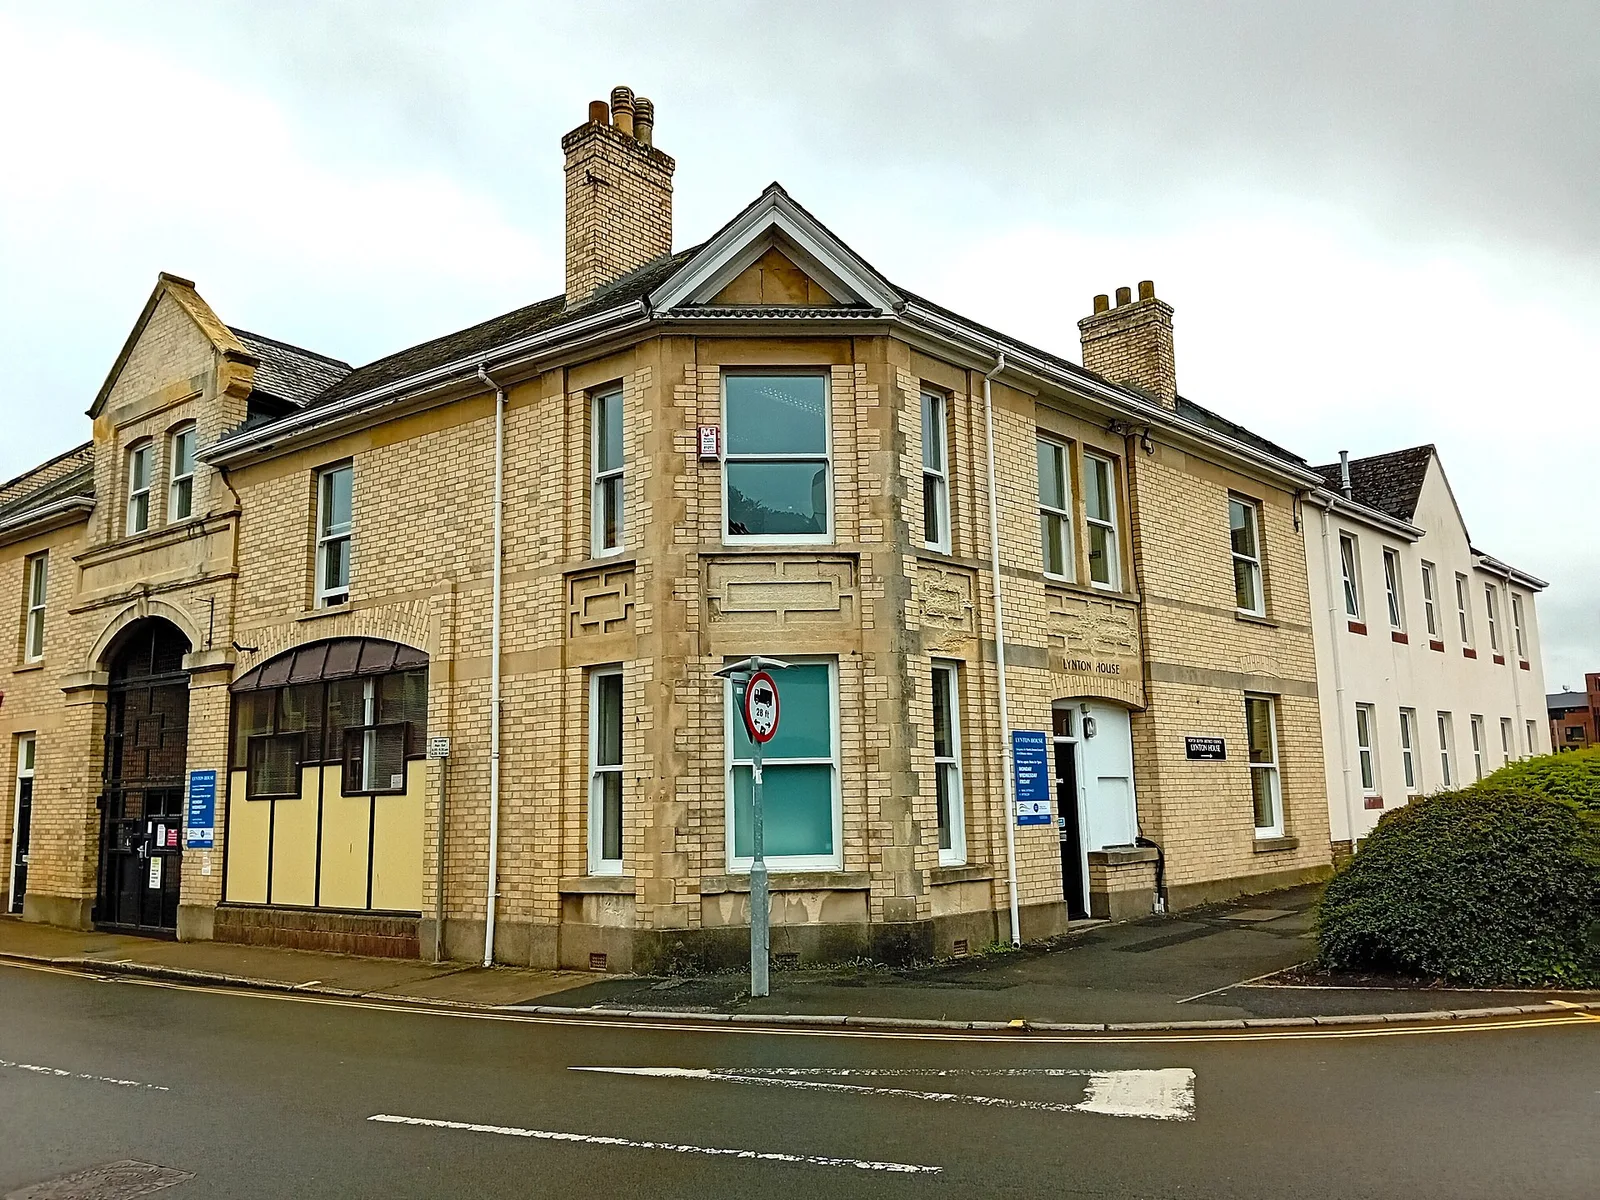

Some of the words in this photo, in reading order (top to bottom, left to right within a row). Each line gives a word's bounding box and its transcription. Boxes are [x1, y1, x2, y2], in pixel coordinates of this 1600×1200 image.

[1062, 658, 1092, 672] LYNTON
[1096, 662, 1120, 674] HOUSE
[756, 708, 764, 717] 28
[765, 710, 770, 718] ft
